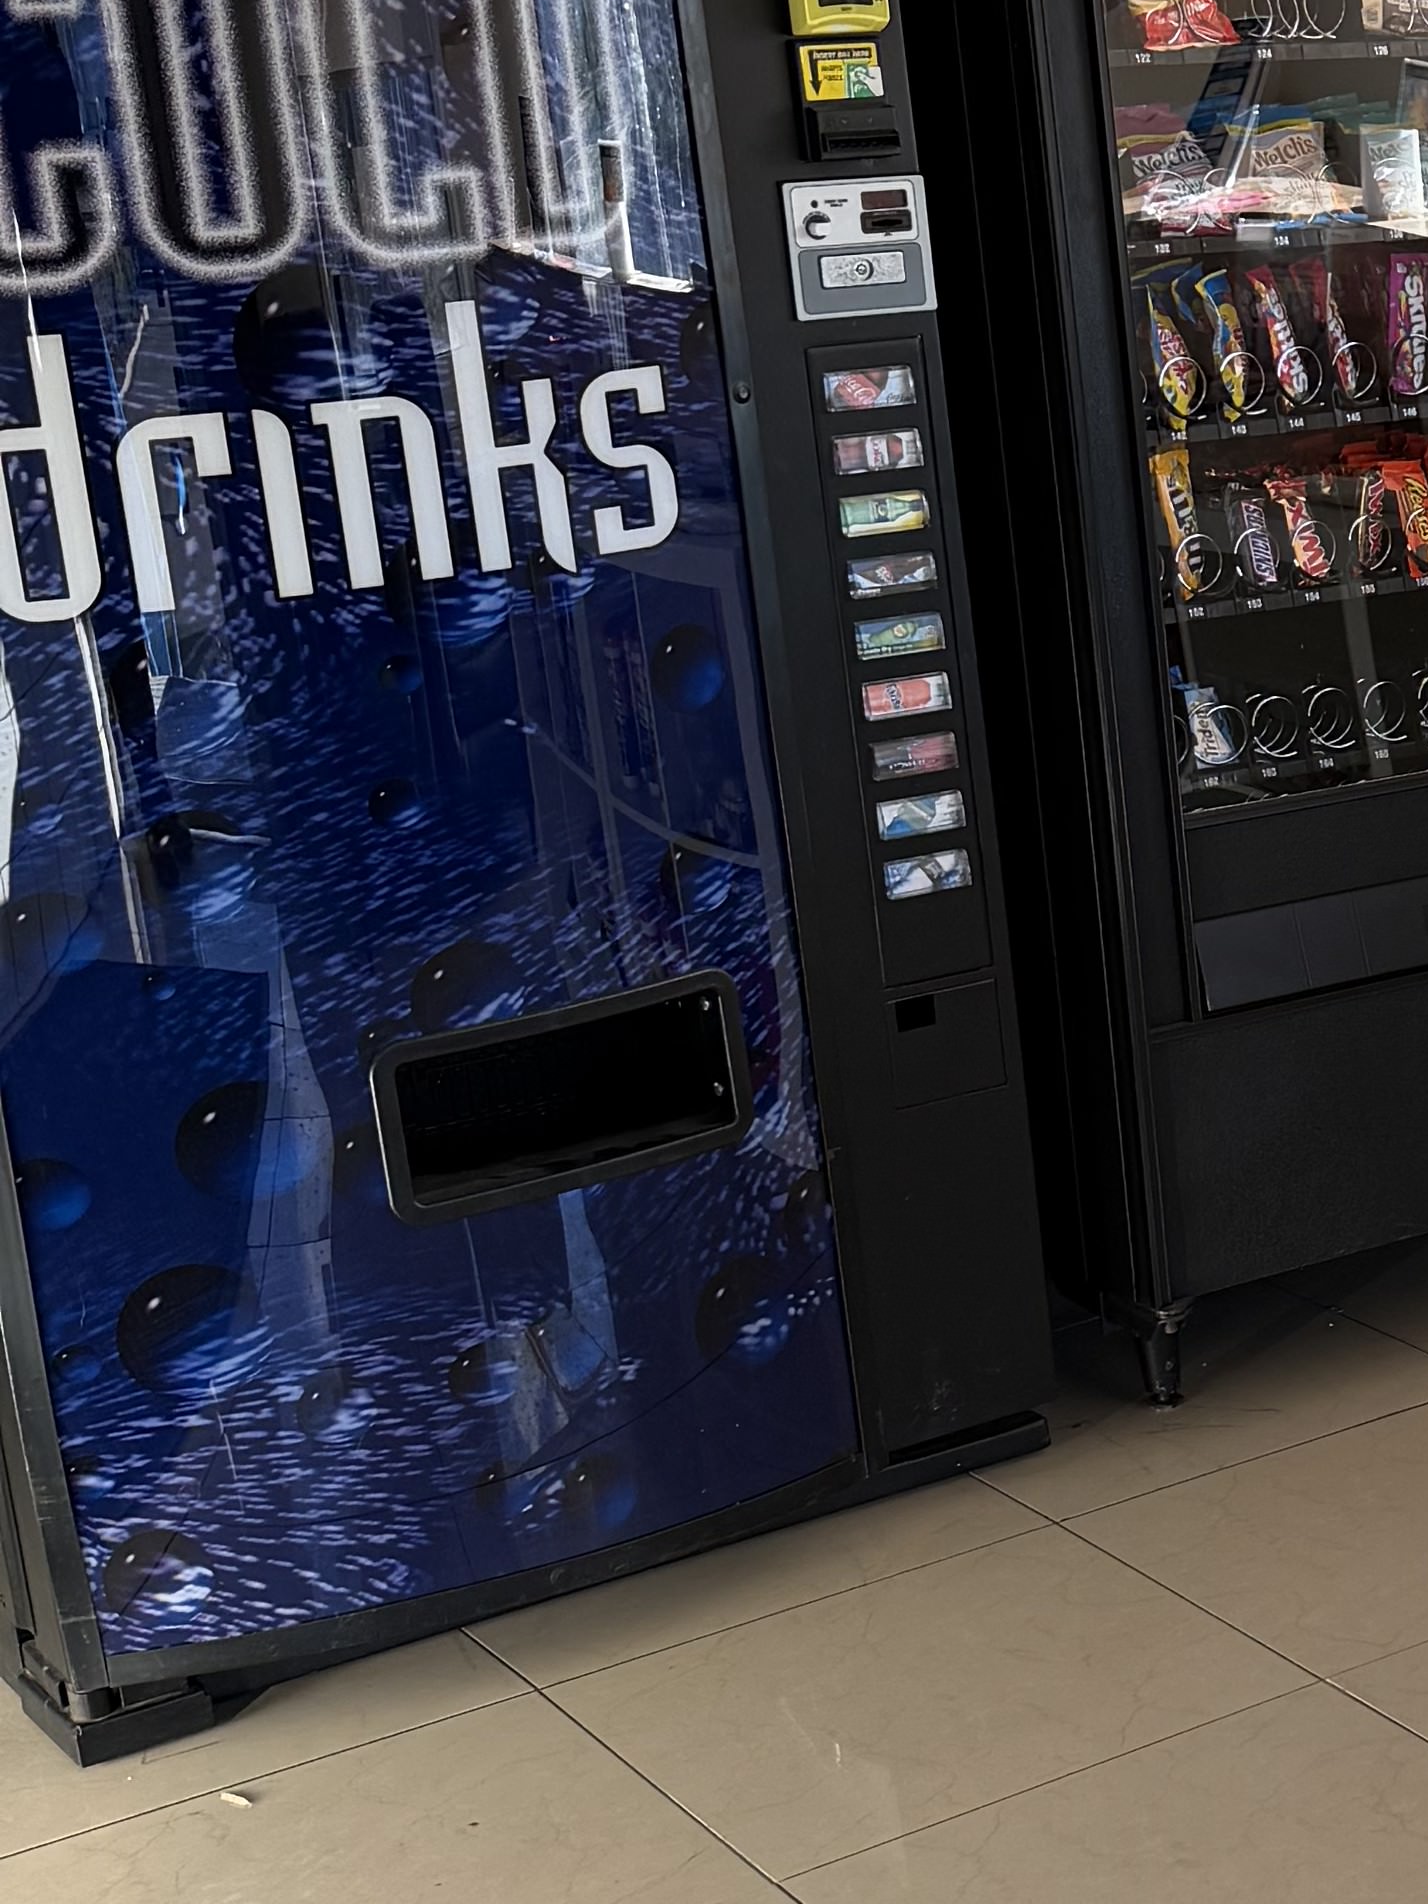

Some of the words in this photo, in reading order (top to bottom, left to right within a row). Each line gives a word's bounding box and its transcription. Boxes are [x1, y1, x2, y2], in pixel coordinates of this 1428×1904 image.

[1133, 143, 1201, 172] Welch's
[1254, 135, 1318, 169] Welch's
[0, 300, 679, 623] drinks
